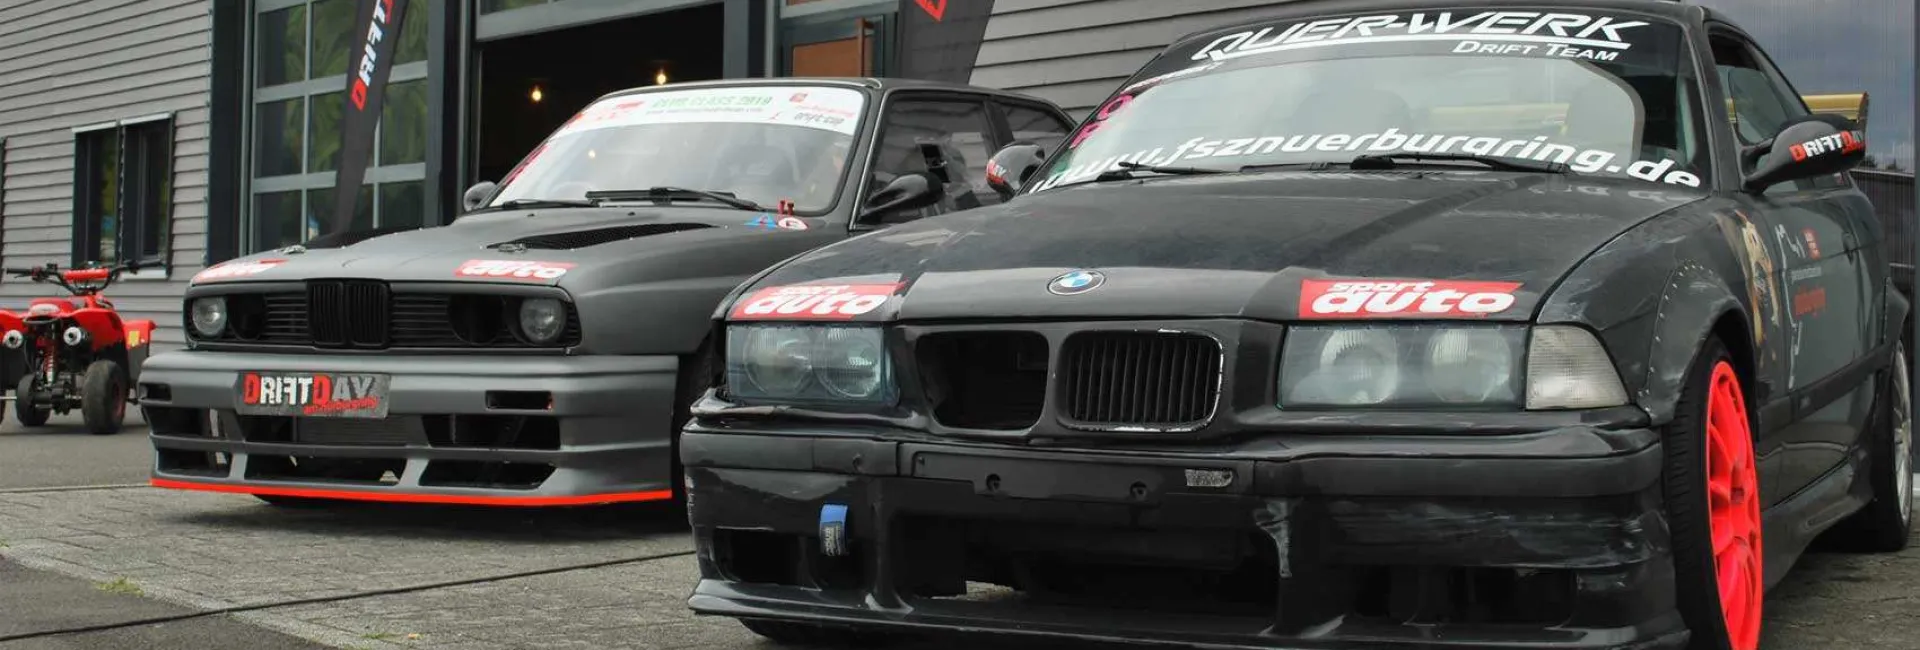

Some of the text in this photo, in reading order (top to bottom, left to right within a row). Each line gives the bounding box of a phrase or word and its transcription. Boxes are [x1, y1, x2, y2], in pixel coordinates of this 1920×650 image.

[1191, 12, 1650, 61] QUER-WERK
[1327, 281, 1436, 292] sport
[744, 291, 888, 314] auto
[1312, 289, 1515, 313] auto
